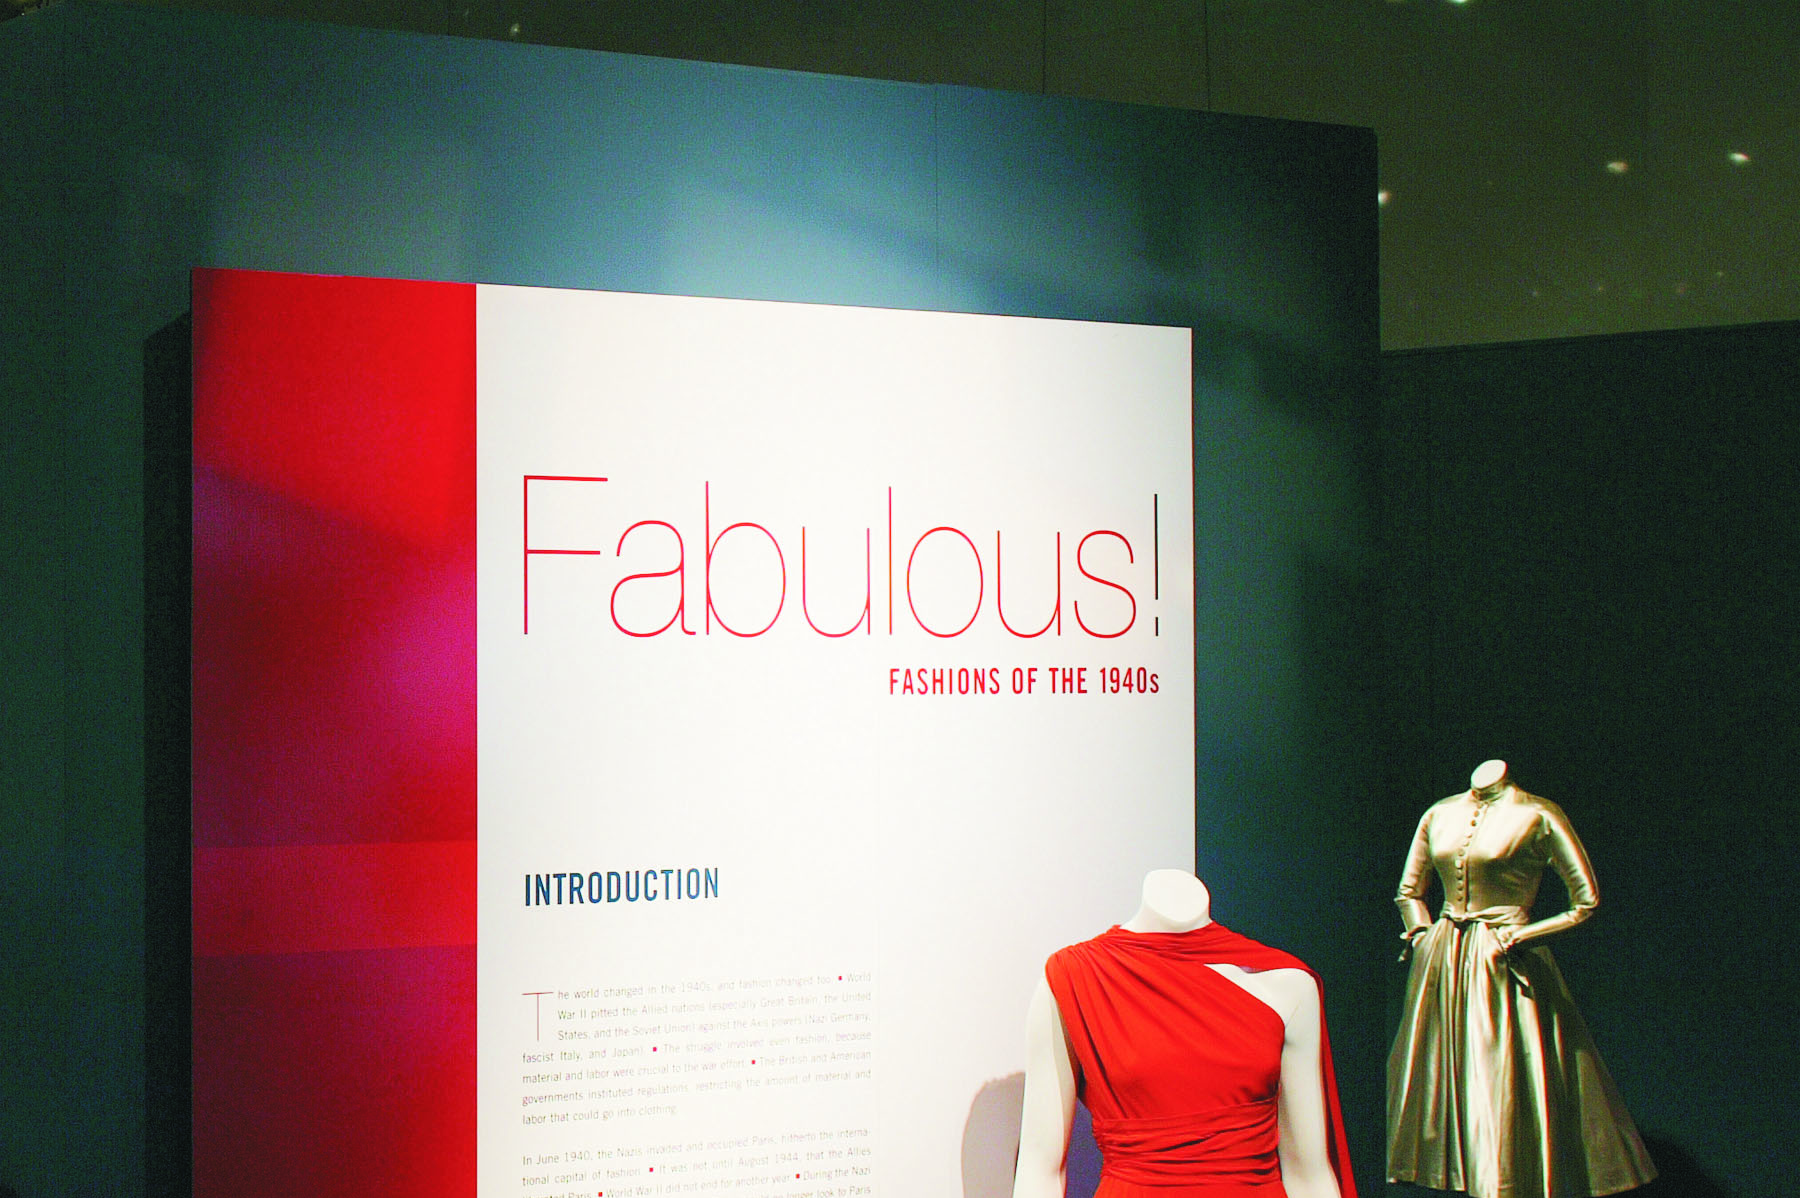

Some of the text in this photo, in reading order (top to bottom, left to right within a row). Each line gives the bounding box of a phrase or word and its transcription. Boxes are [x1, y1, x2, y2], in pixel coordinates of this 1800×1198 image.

[523, 474, 1159, 638] Fabulous!
[889, 666, 1160, 695] FASHIONS OF THE 1940s
[524, 866, 719, 907] INTRODUCTION
